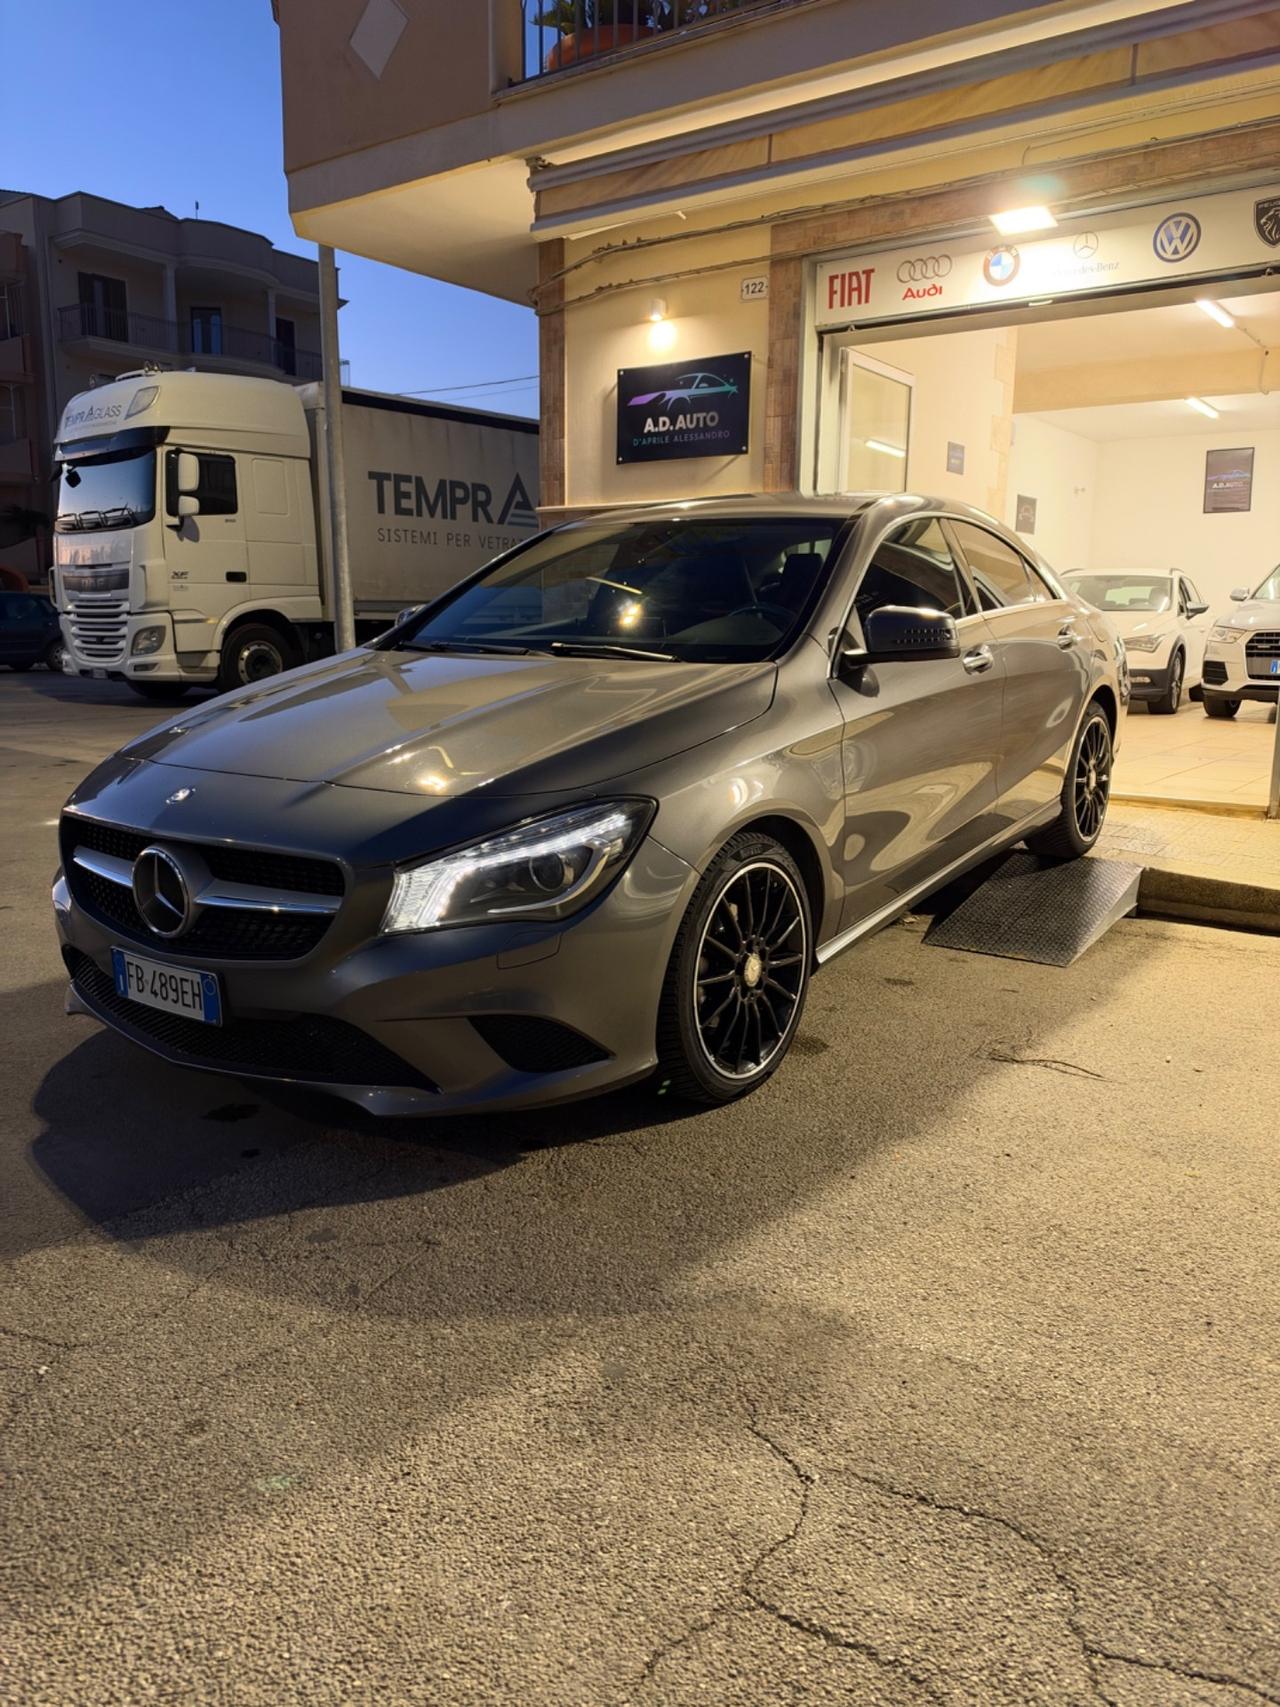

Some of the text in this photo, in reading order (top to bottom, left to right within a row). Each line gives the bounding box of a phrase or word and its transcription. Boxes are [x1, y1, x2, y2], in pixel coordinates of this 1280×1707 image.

[744, 281, 765, 294] 122
[828, 268, 875, 309] FIAT
[902, 284, 943, 300] Audi
[633, 430, 730, 447] D'APRILE ALESSANDRO
[368, 471, 539, 528] TEMPRA
[377, 527, 526, 551] SISTEMI PER VETRA
